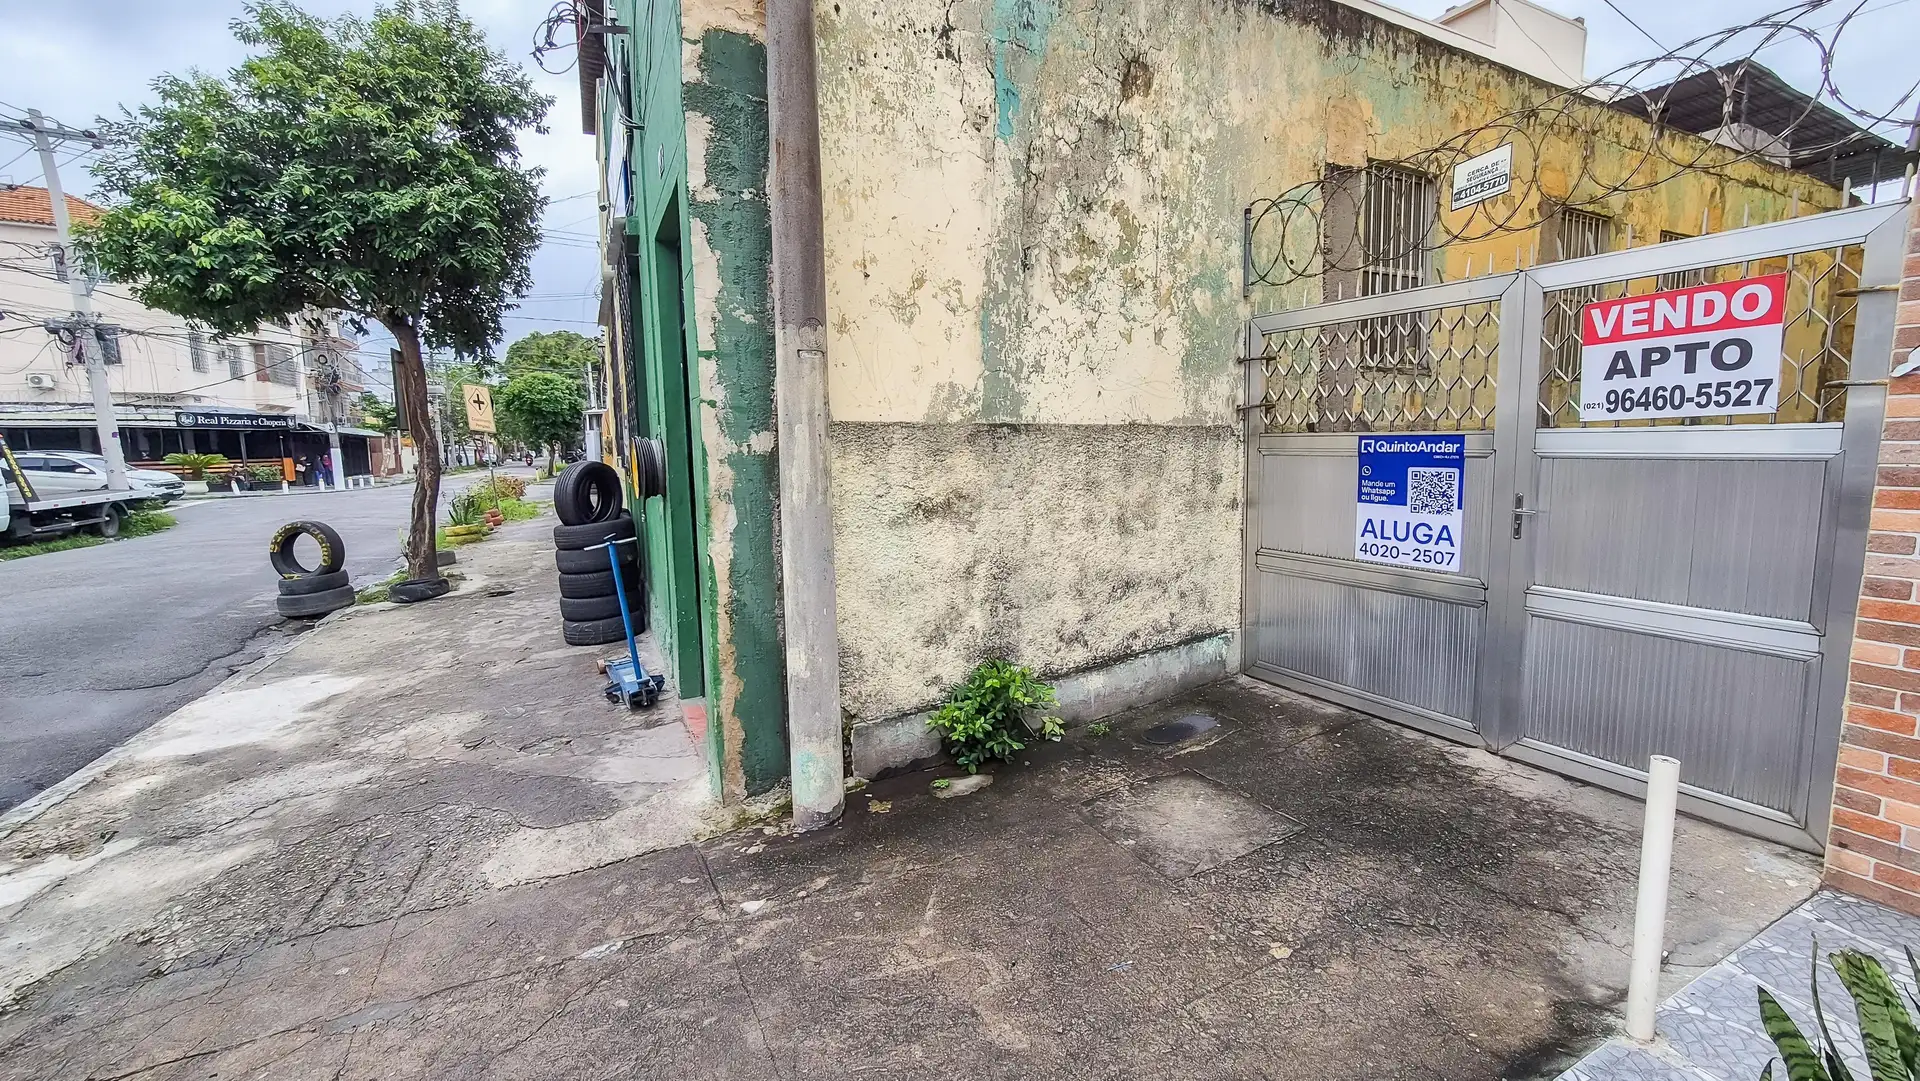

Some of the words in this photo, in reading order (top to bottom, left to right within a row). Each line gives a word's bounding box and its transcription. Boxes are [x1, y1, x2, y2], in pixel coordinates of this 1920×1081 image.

[1467, 165, 1489, 177] CERCA
[1490, 160, 1499, 168] DE
[1460, 176, 1506, 199] 4104-5770
[1590, 283, 1773, 339] VENDO
[1603, 337, 1754, 381] APTO
[1583, 402, 1604, 411] (021)
[1605, 378, 1774, 414] 96460-5527
[197, 415, 218, 425] Real
[220, 416, 252, 426] Pizzaria
[258, 417, 287, 428] Choperia
[1375, 440, 1460, 453] QuintoAndar
[1361, 480, 1384, 488] Mande
[1361, 487, 1396, 496] Whatsapp
[1370, 494, 1389, 502] ligue.
[1360, 518, 1455, 547] ALUGA
[1359, 542, 1456, 566] 4020-2507
